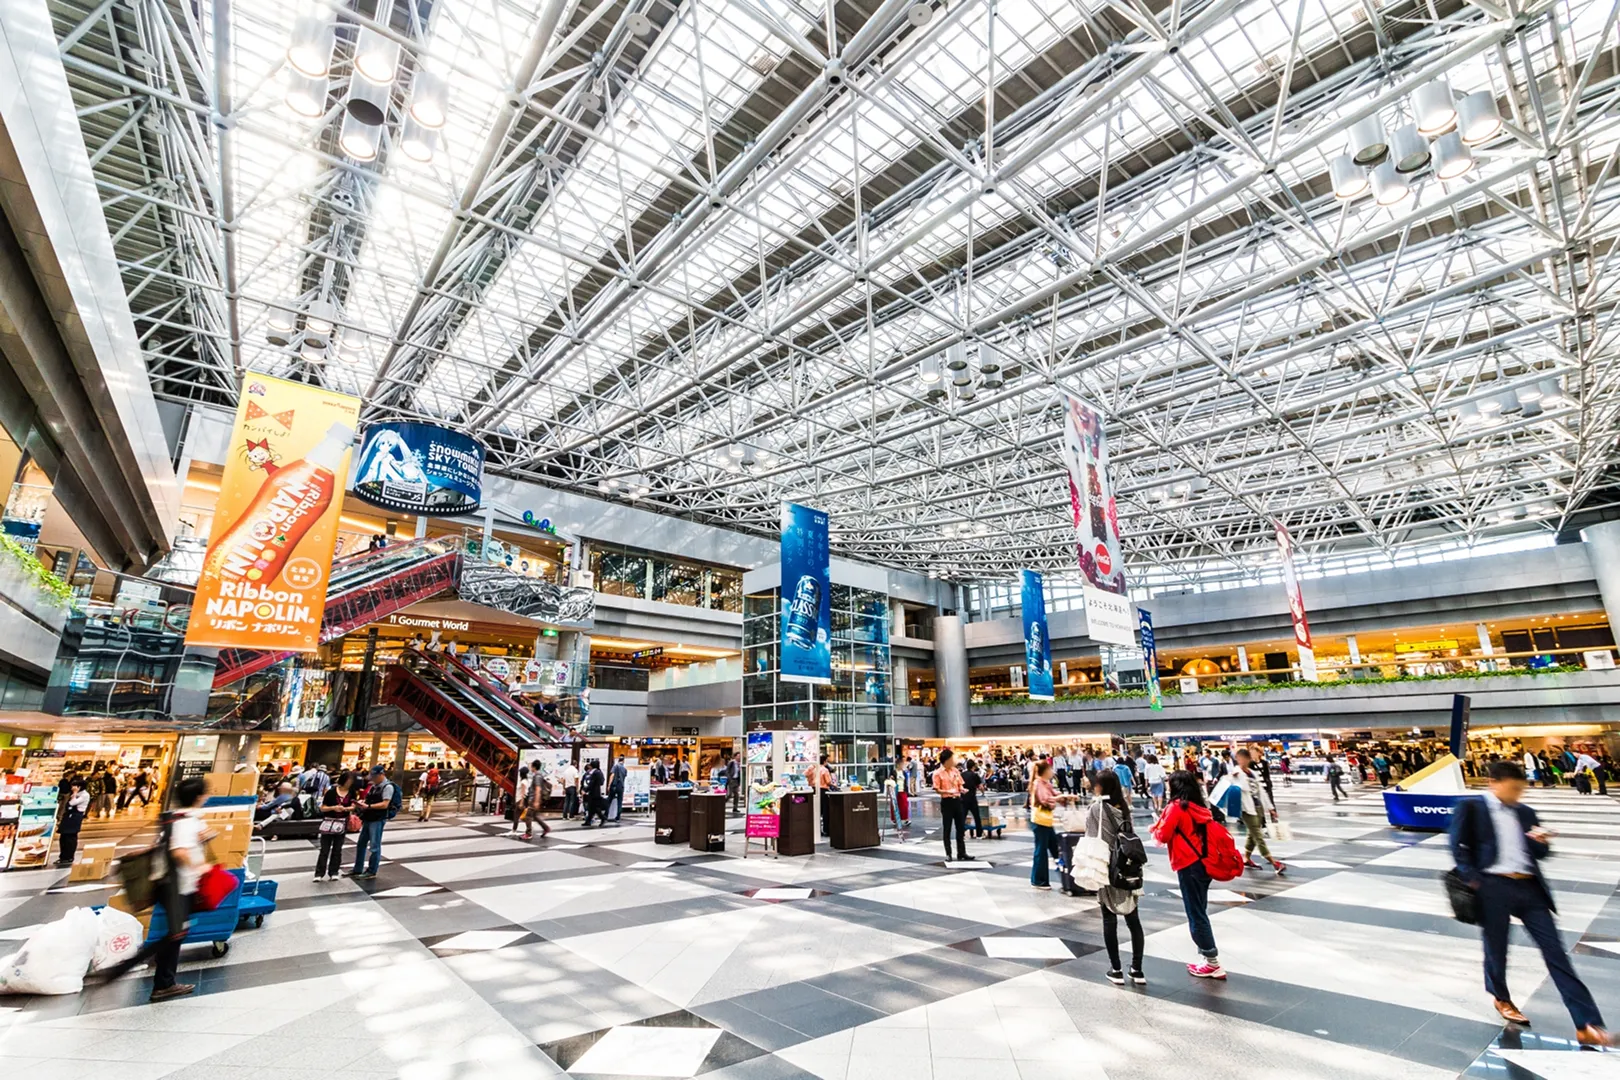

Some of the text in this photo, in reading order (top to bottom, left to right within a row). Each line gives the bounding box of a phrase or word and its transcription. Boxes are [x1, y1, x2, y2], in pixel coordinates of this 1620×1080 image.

[280, 487, 321, 532] Ribbon
[220, 581, 303, 604] Ribbon
[210, 619, 248, 631] リボン
[398, 616, 469, 631] Gourmet World
[1413, 806, 1455, 815] ROYCE
